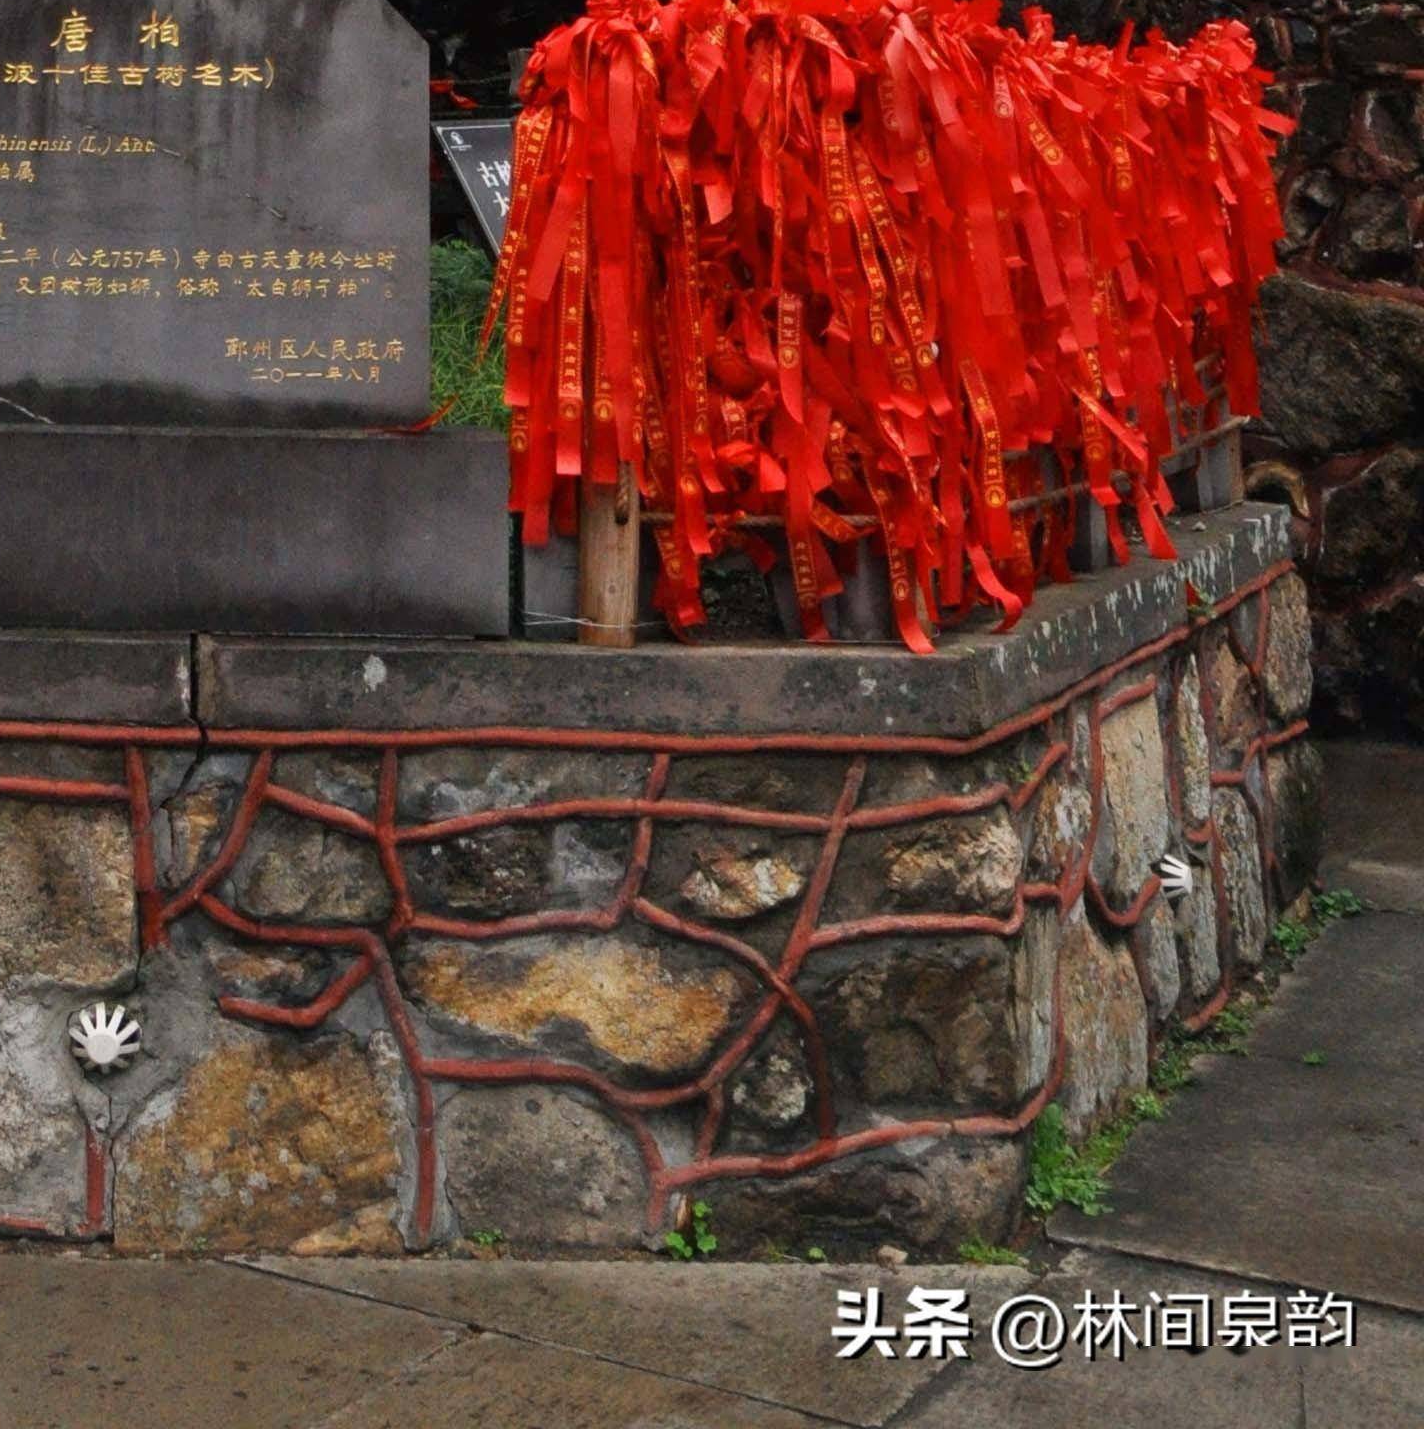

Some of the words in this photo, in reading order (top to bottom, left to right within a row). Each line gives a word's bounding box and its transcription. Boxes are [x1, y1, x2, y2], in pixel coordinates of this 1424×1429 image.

[50, 10, 180, 53] 唐柏
[225, 338, 406, 362] 鄞州区人民政府
